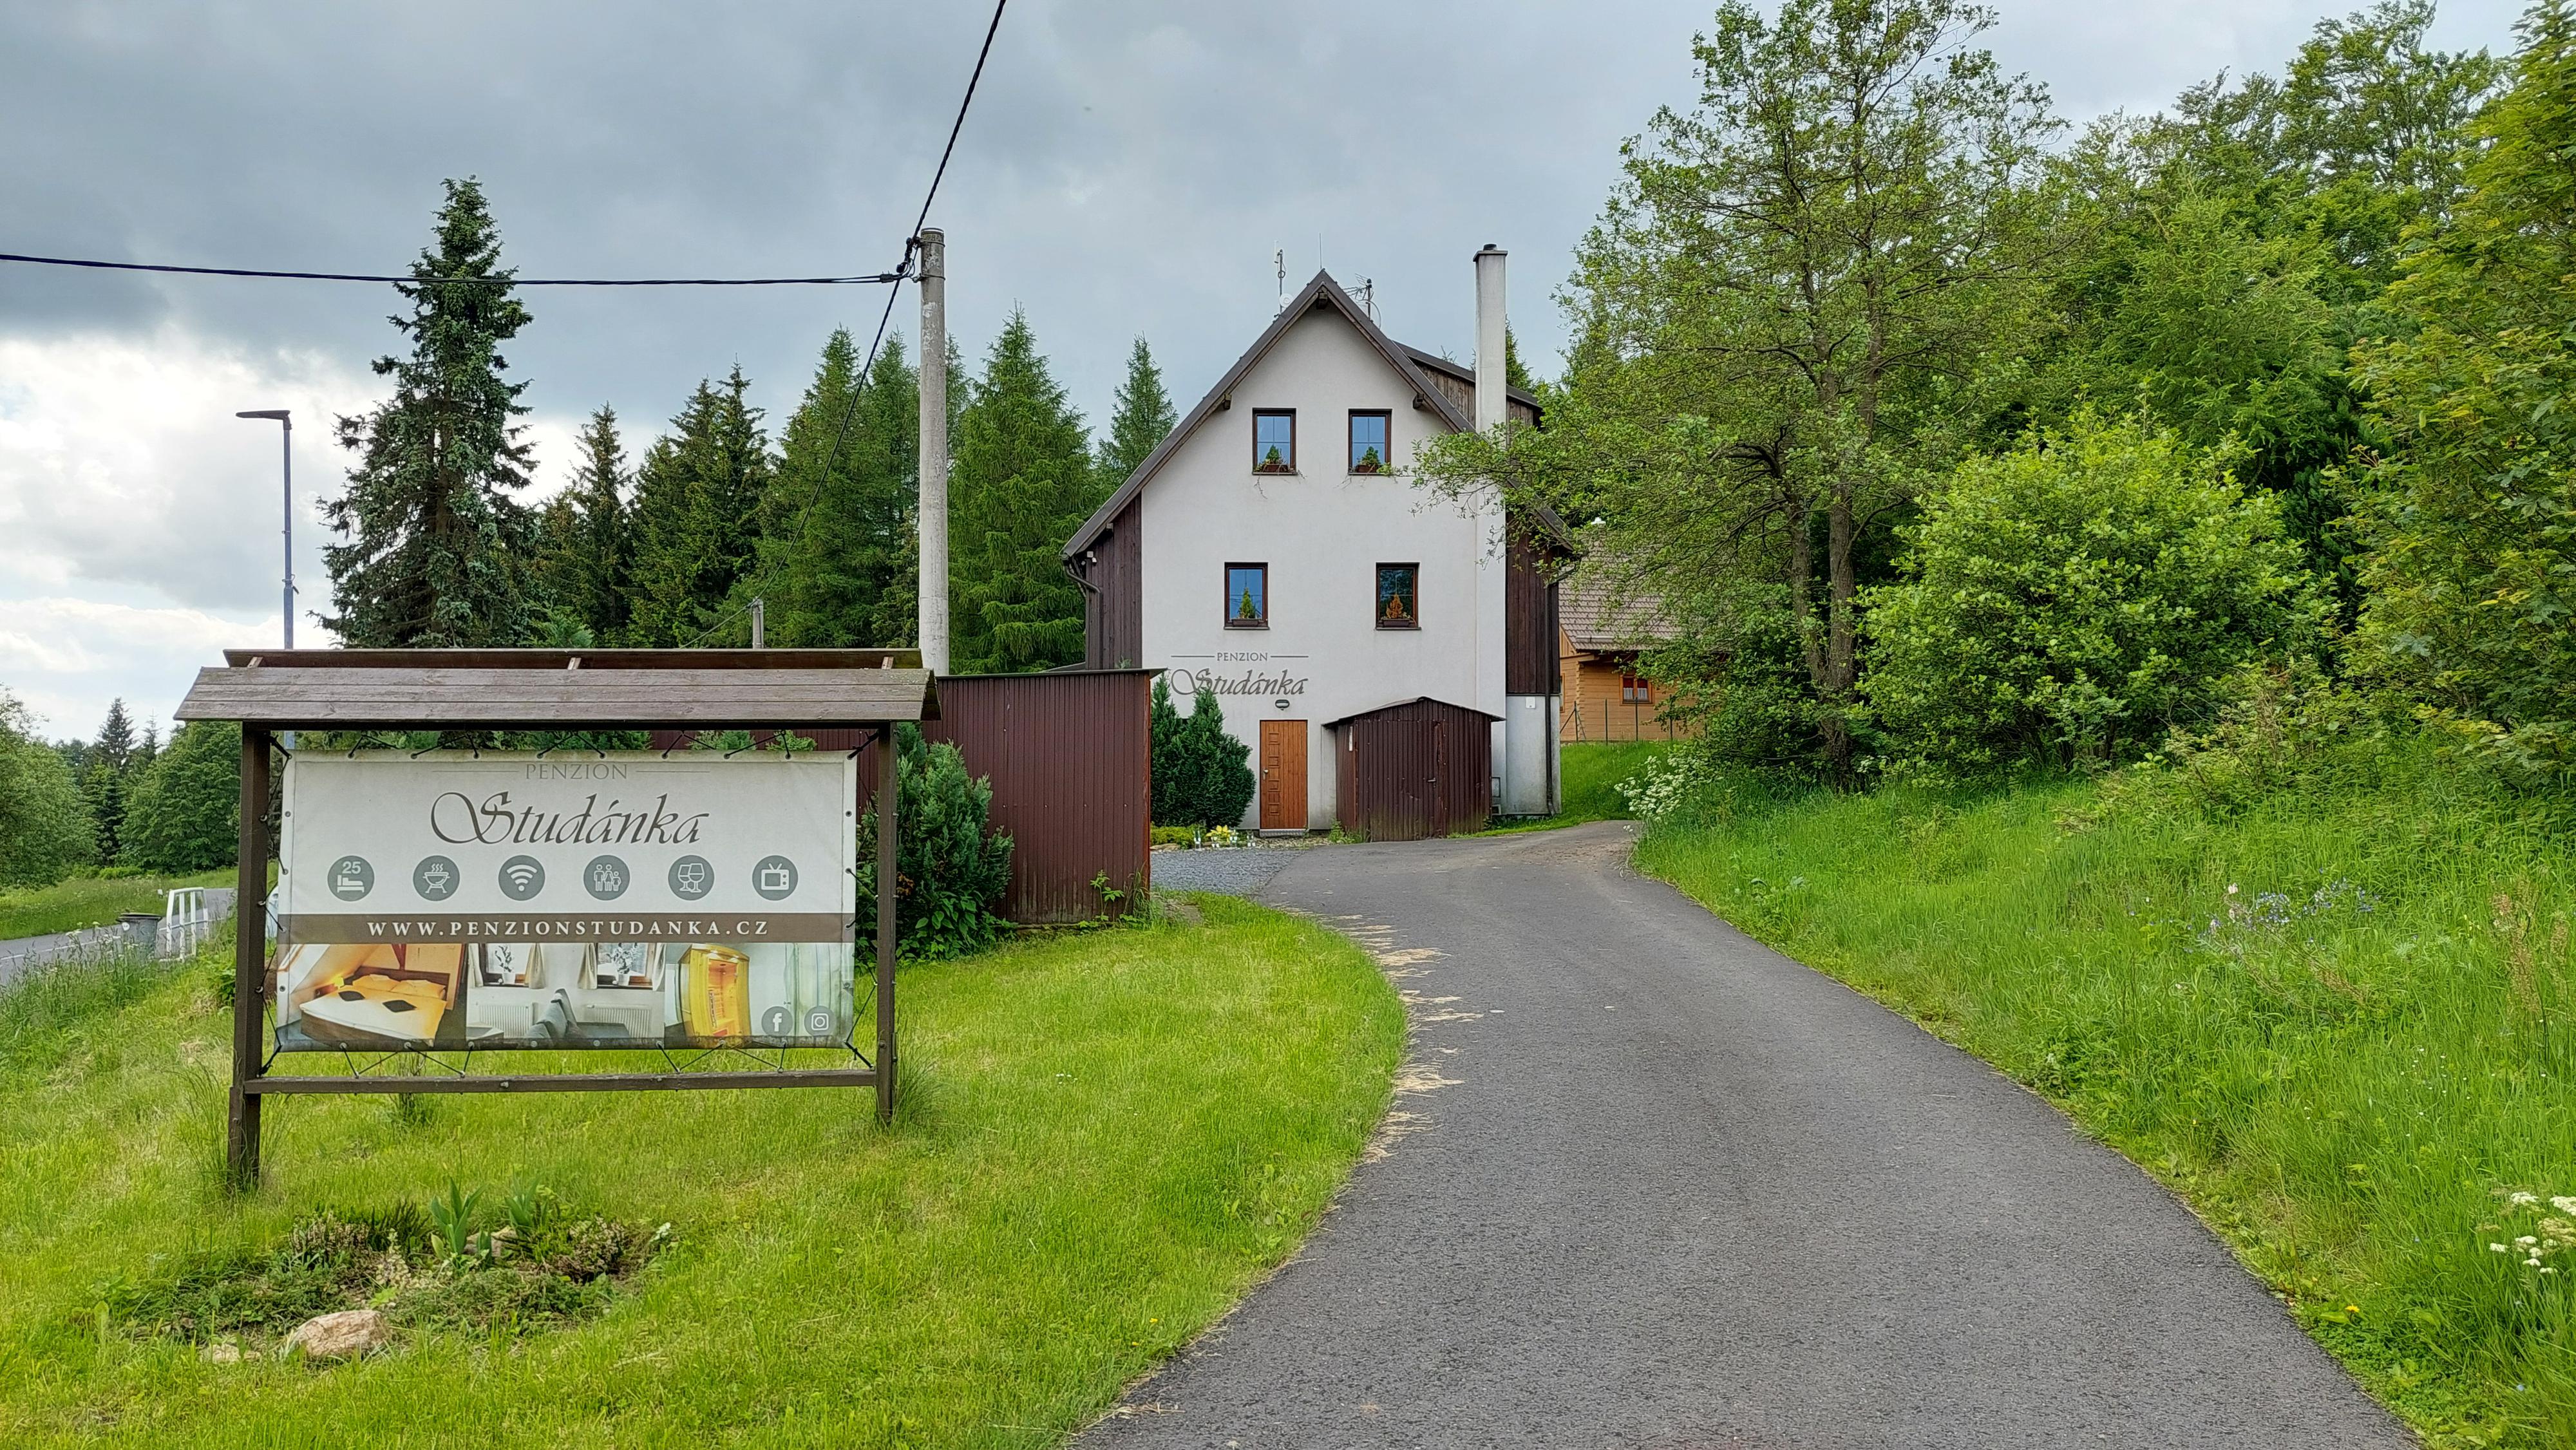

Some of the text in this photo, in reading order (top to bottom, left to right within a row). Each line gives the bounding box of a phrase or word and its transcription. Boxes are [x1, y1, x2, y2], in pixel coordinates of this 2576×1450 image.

[1217, 652, 1268, 661] PENZION
[1171, 668, 1309, 695] Studánka
[526, 764, 627, 780] PENZION
[431, 791, 710, 845] Studánka
[342, 861, 361, 874] 25
[366, 921, 769, 936] WWW.PENZIONSTUDANKA.CZ
